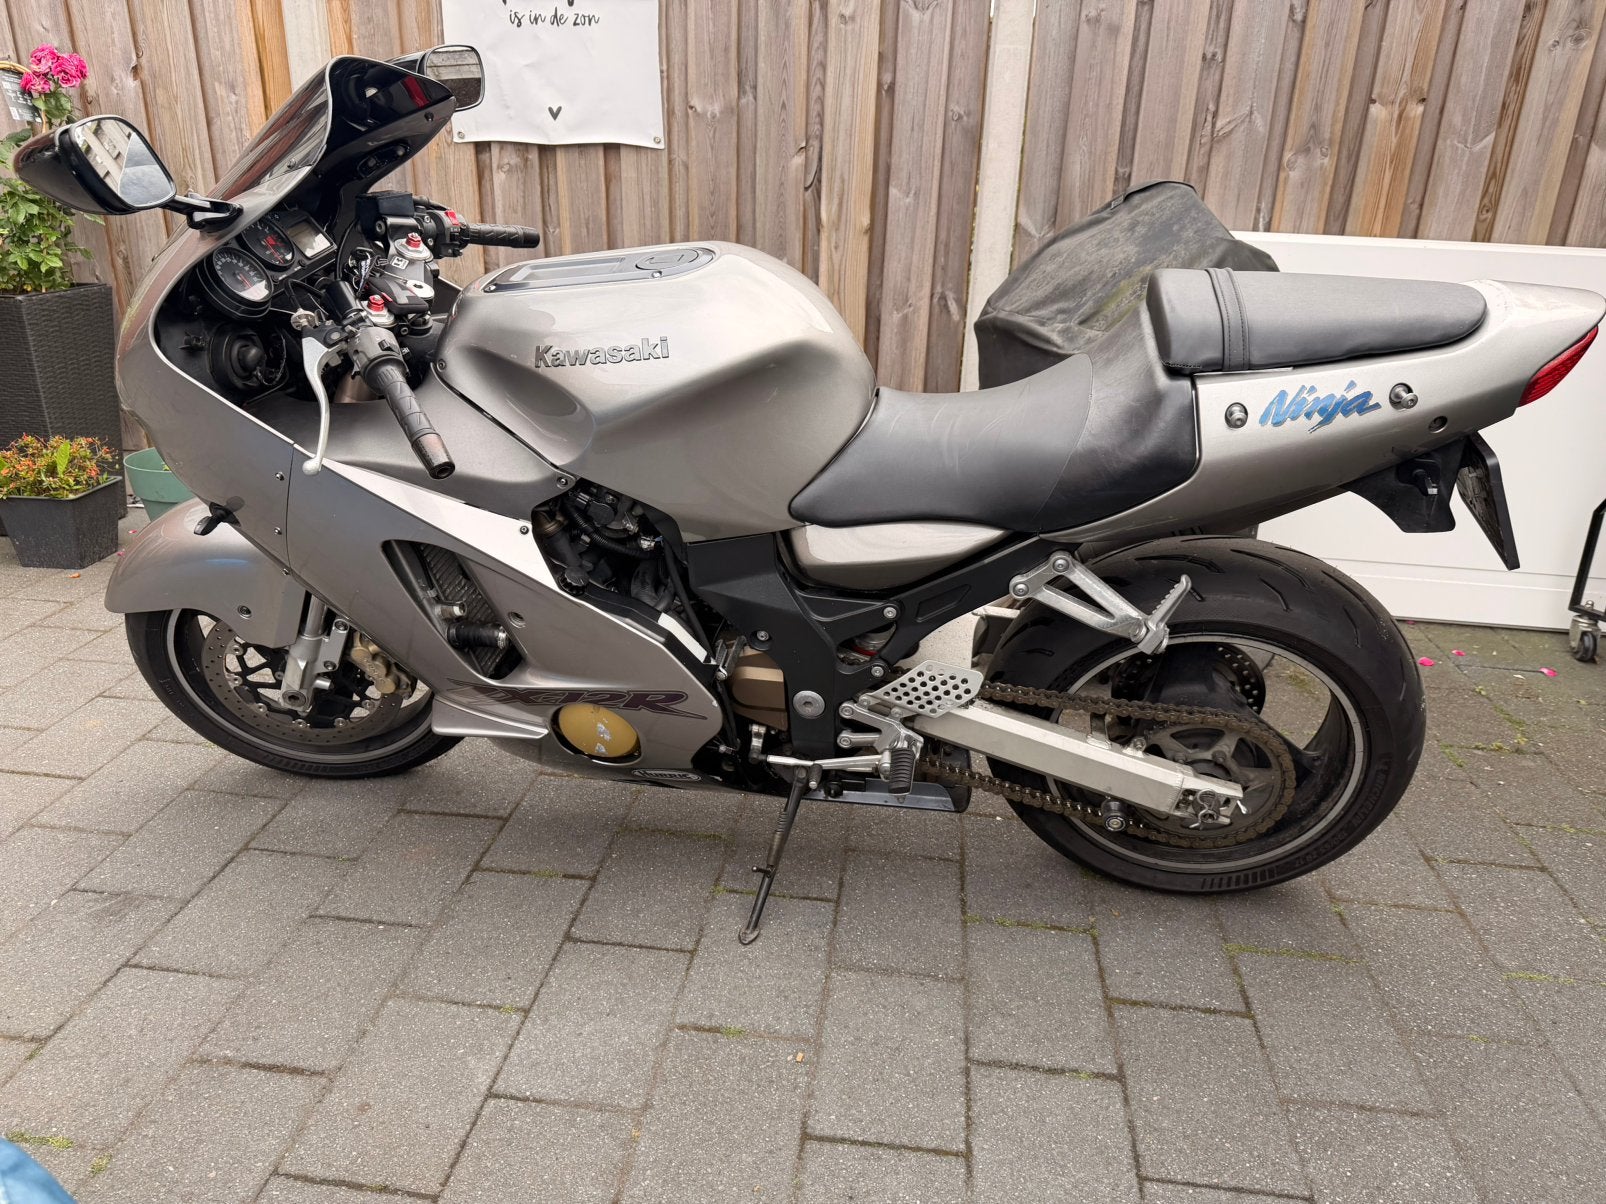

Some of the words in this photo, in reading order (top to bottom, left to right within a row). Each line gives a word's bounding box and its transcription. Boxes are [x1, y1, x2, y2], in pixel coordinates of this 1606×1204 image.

[509, 9, 525, 28] is
[529, 10, 546, 25] in
[549, 6, 568, 27] de
[572, 13, 600, 27] zon
[534, 336, 670, 369] Kawasaki
[1258, 379, 1382, 434] Ninja
